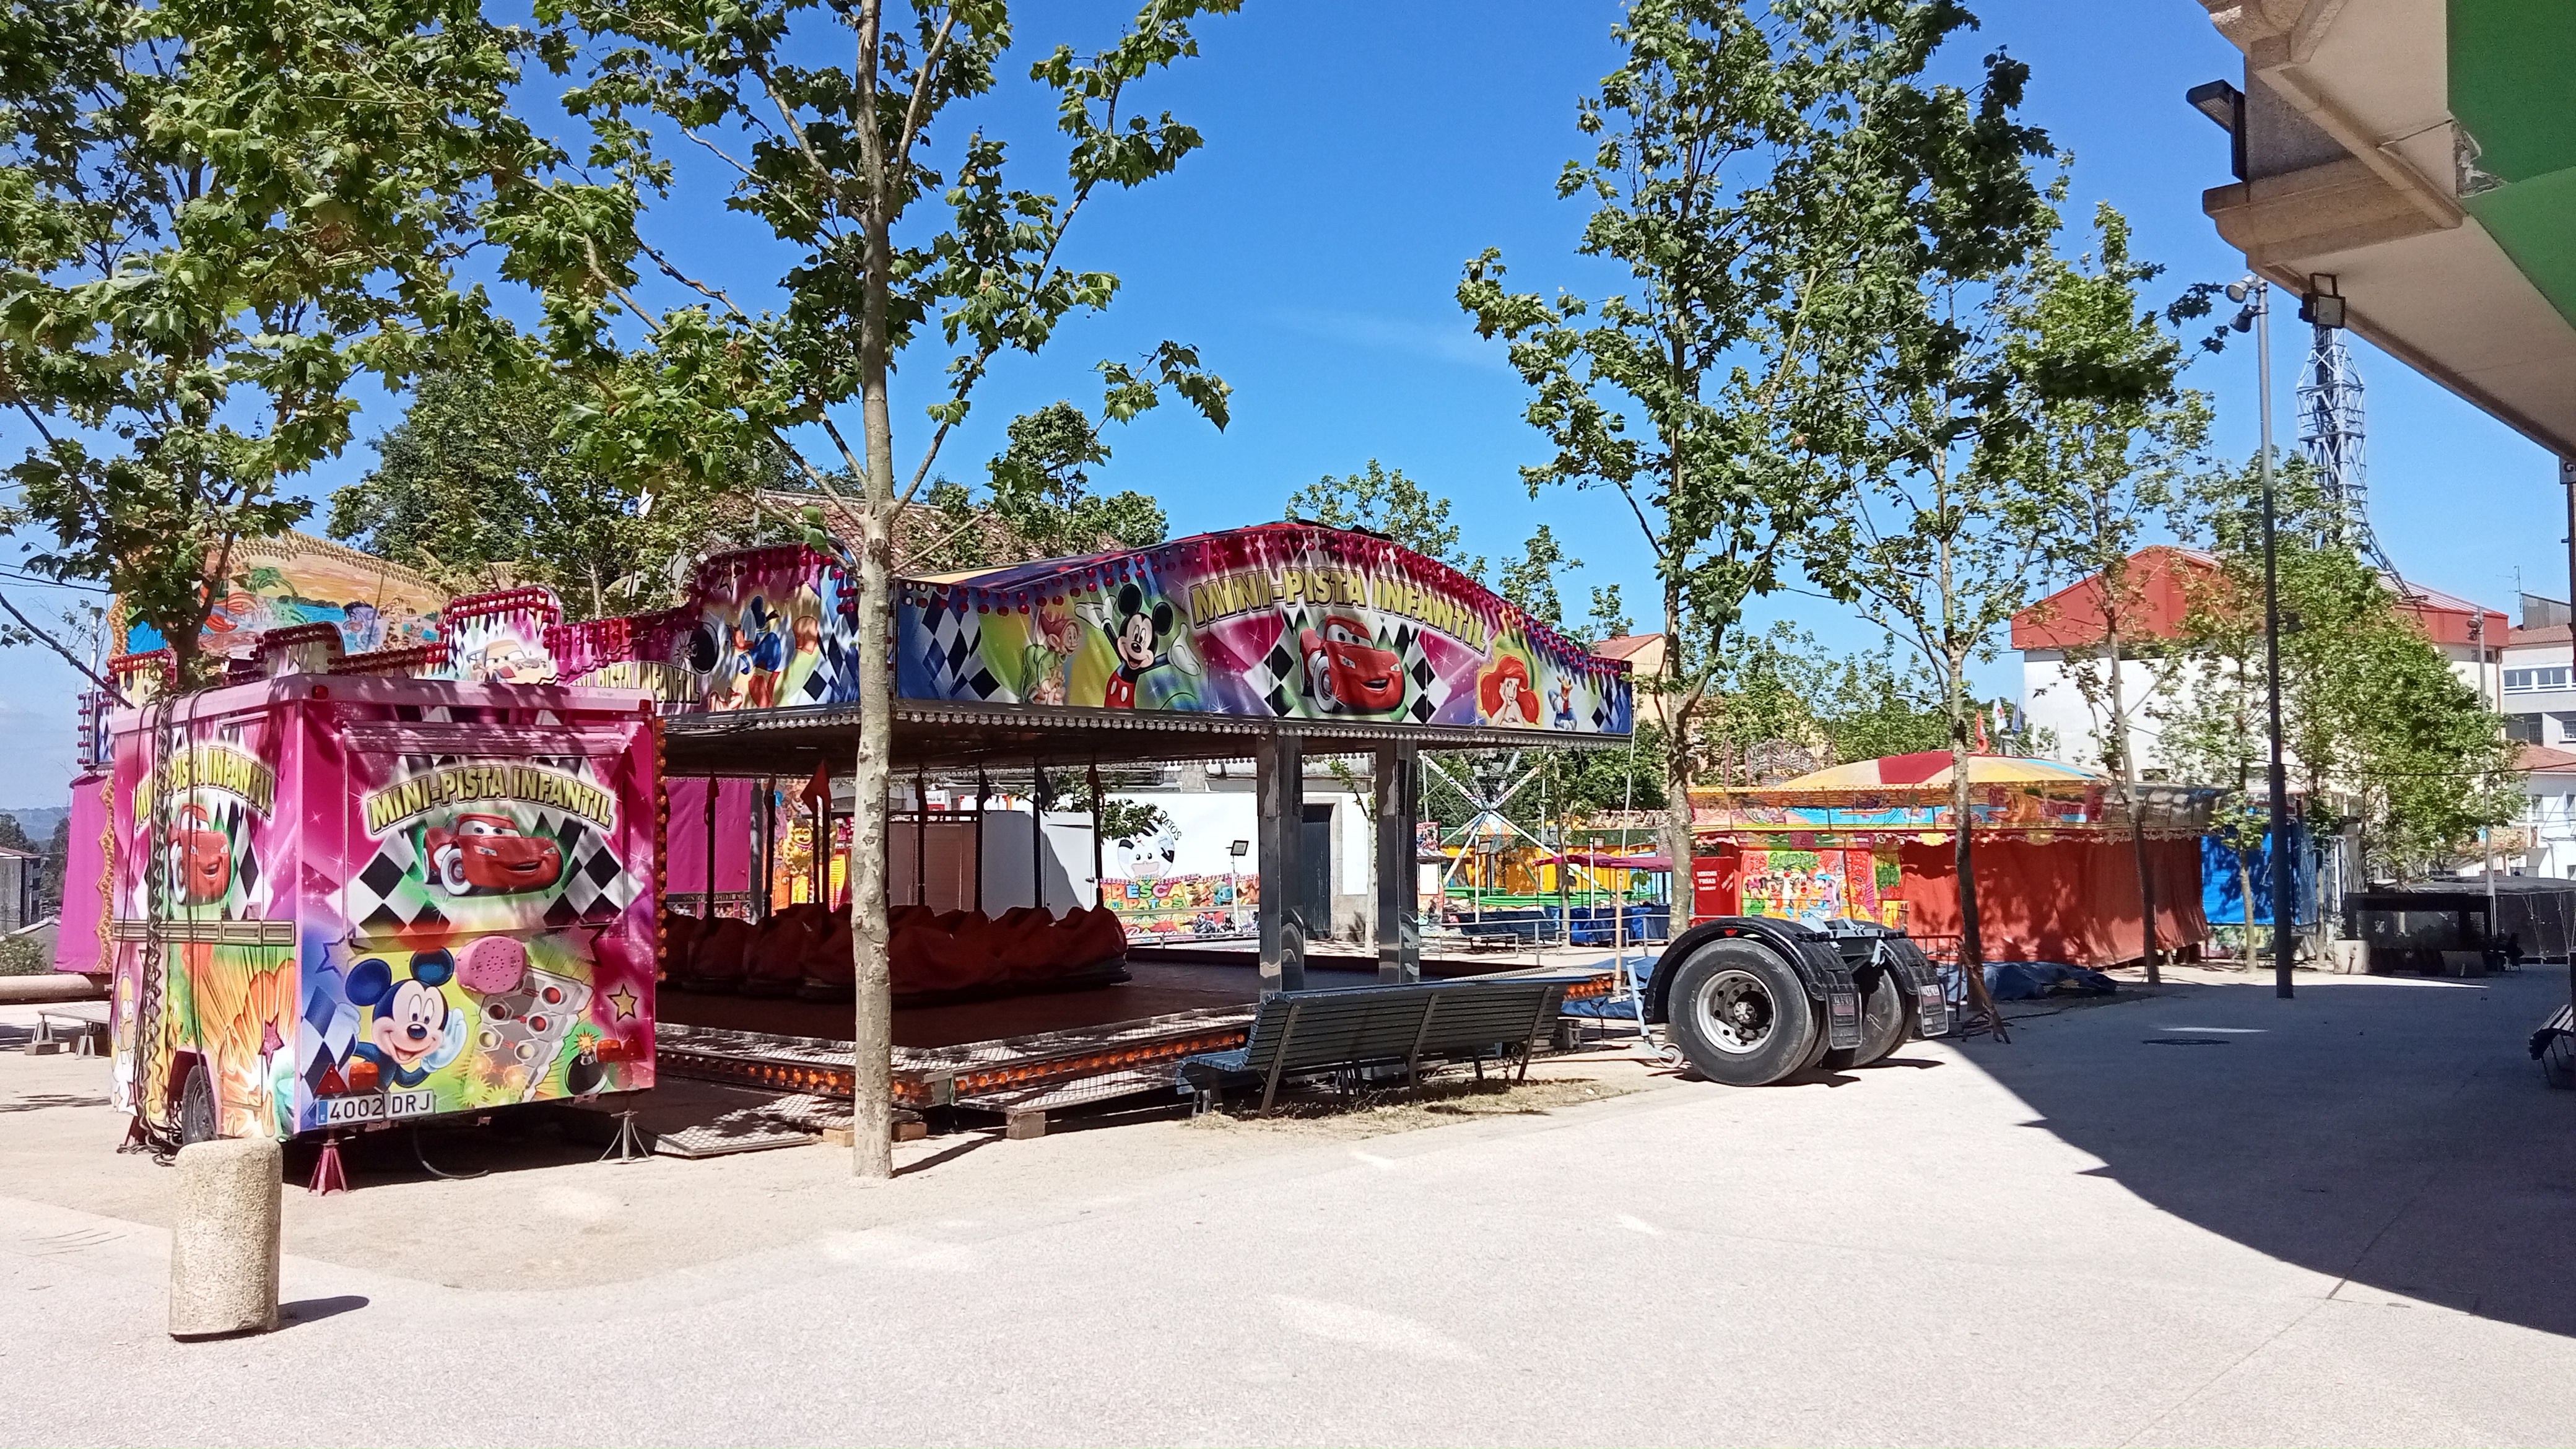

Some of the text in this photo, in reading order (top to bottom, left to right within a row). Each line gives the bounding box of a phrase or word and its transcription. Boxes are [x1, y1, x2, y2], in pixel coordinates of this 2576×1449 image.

[1191, 567, 1486, 656] MINI-PISTA INFANTIL
[207, 746, 272, 821] INFANTIL
[368, 765, 613, 833] MINI-PISTA INFANTIL
[1111, 883, 1185, 899] PESCA
[1112, 898, 1183, 910] DE PATOS
[329, 1092, 430, 1120] 4002 DRJ
